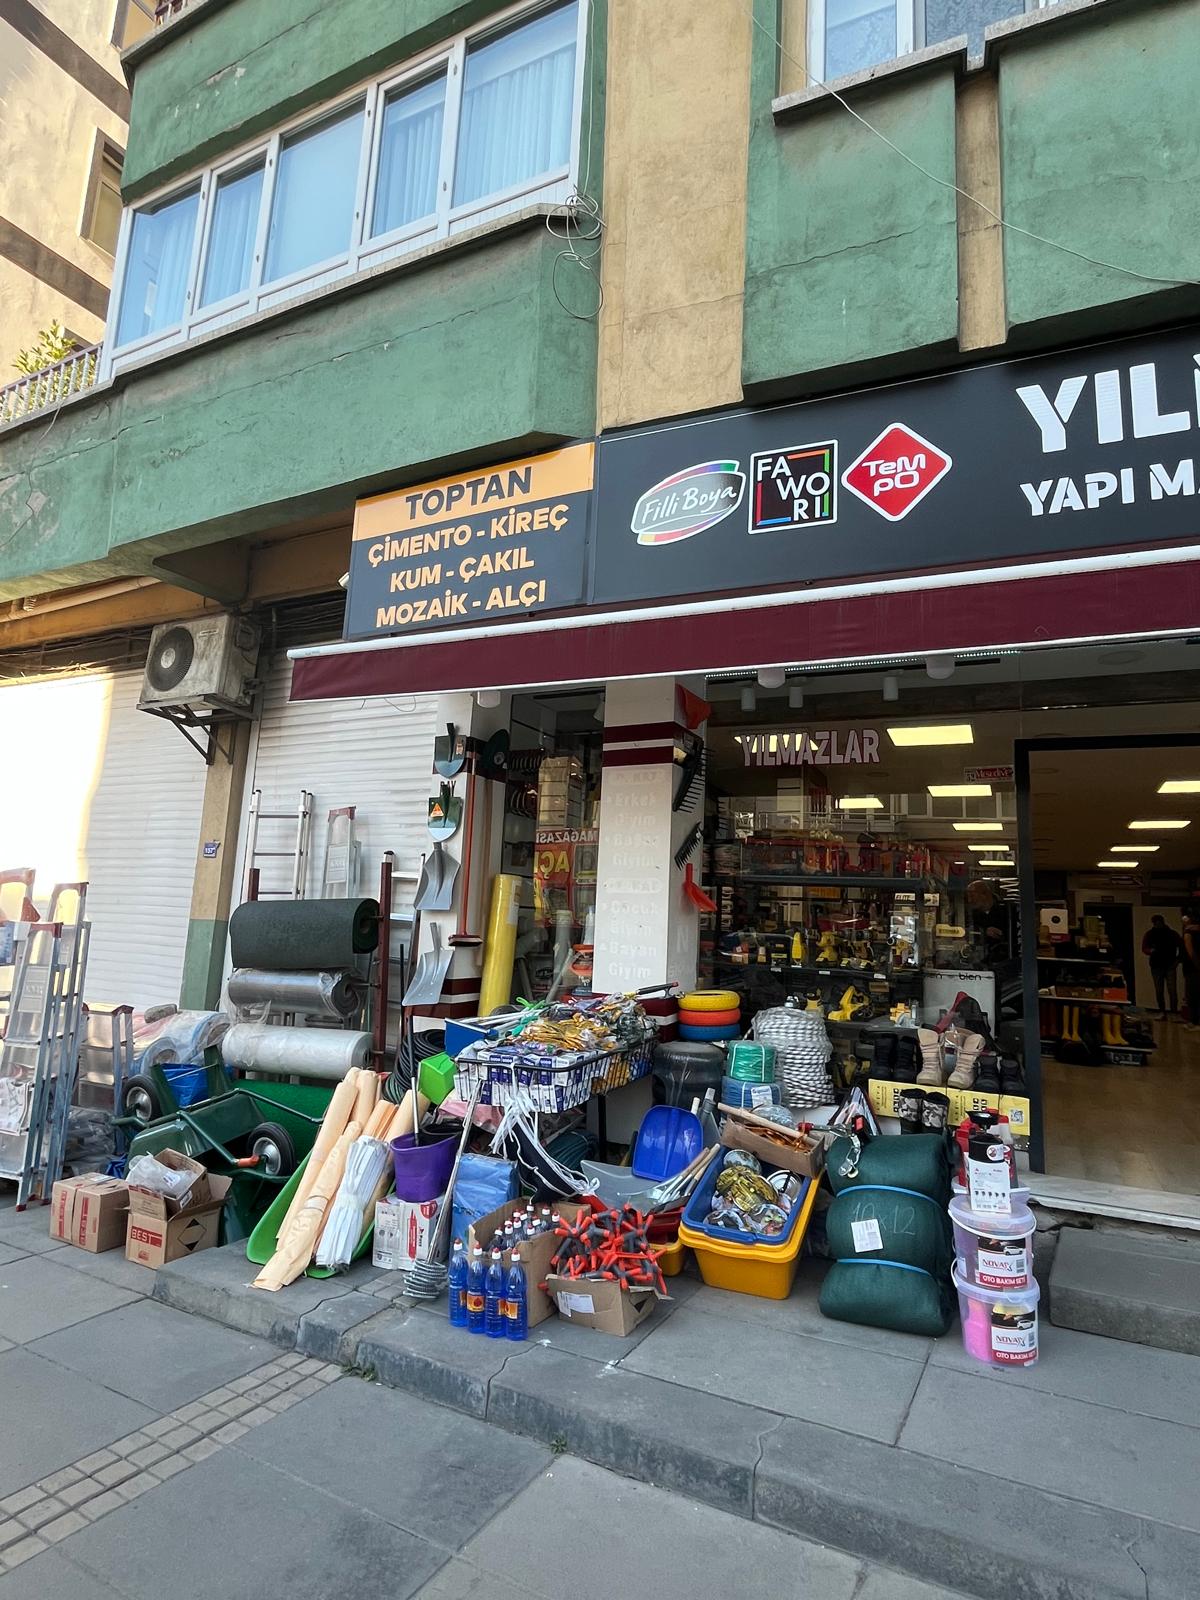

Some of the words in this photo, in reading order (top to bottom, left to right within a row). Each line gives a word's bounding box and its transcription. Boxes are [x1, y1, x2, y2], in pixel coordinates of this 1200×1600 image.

[1015, 354, 1200, 453] YIL
[405, 466, 532, 520] TOPTAN
[641, 496, 677, 525] Filli
[683, 485, 737, 512] Boya
[1019, 467, 1135, 516] YAPI
[1149, 459, 1200, 500] M
[368, 524, 472, 567] ÇİMENTO
[490, 504, 569, 540] KİREÇ
[389, 563, 441, 593] KUM
[459, 547, 535, 583] ÇAKIL
[376, 589, 468, 628] MOZAİK
[485, 579, 547, 610] ALÇI
[740, 729, 880, 767] YILMAZLAR
[131, 1228, 158, 1246] BEST
